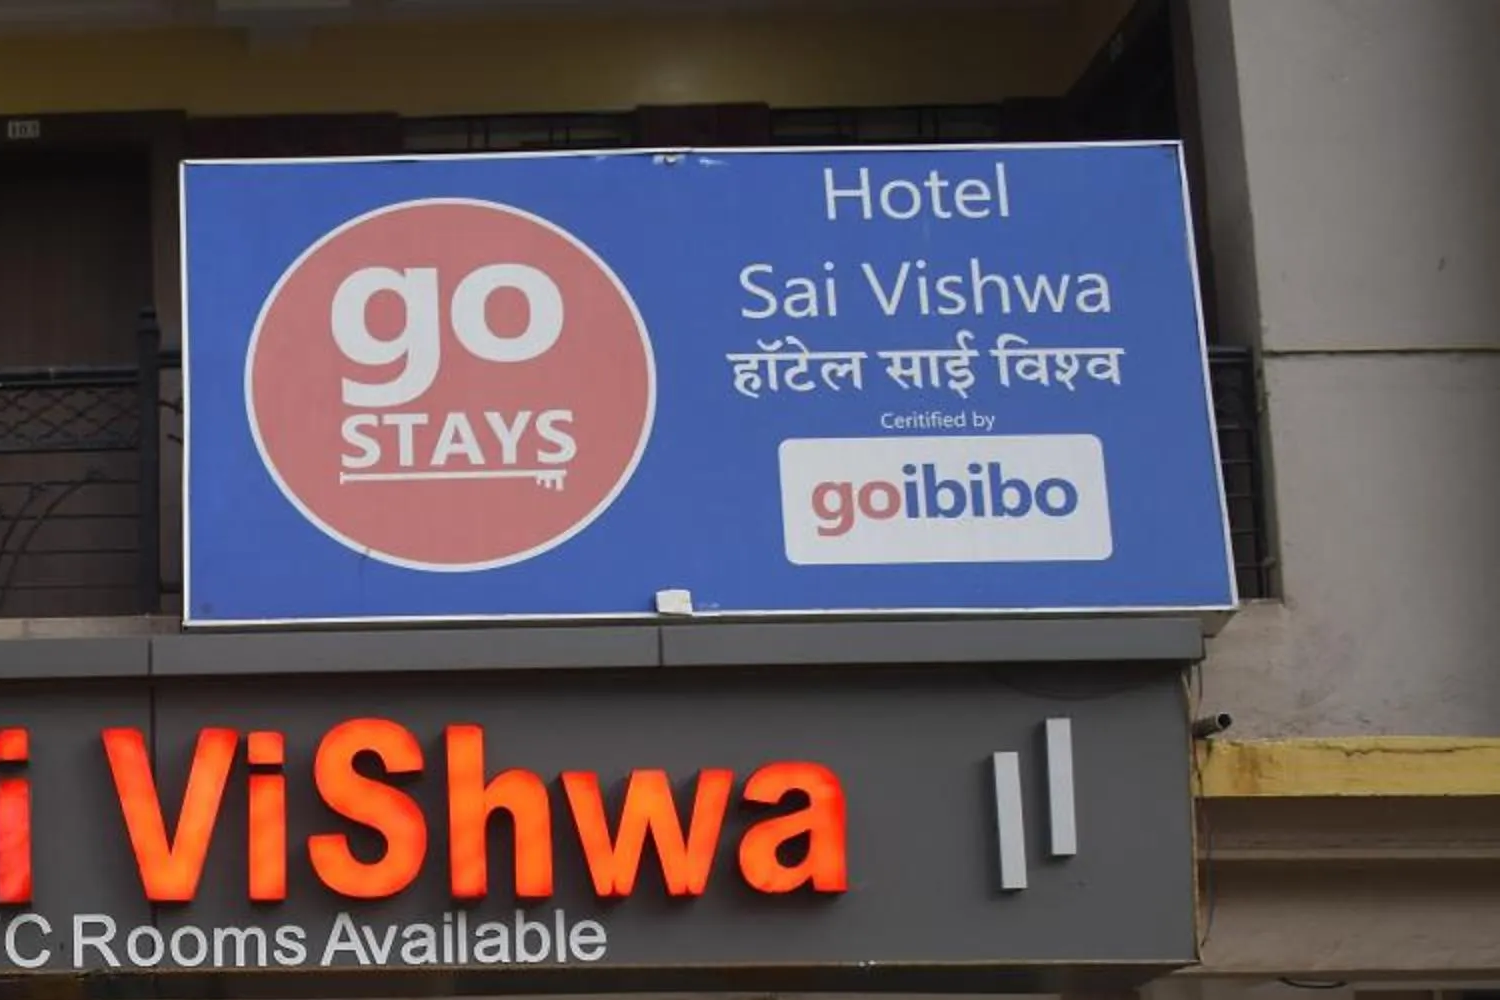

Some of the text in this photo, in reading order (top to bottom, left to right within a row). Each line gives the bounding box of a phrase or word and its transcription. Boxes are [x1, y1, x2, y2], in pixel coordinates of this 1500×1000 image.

[823, 162, 1011, 221] Hotel
[738, 257, 1112, 320] Sai Vishwa
[330, 262, 565, 407] go
[726, 330, 1125, 399] हॉटेल साई विश्व
[340, 409, 577, 469] STAYS
[971, 411, 996, 432] by
[811, 462, 1079, 537] goibibo
[73, 914, 308, 970] Rooms
[320, 908, 609, 967] Available
